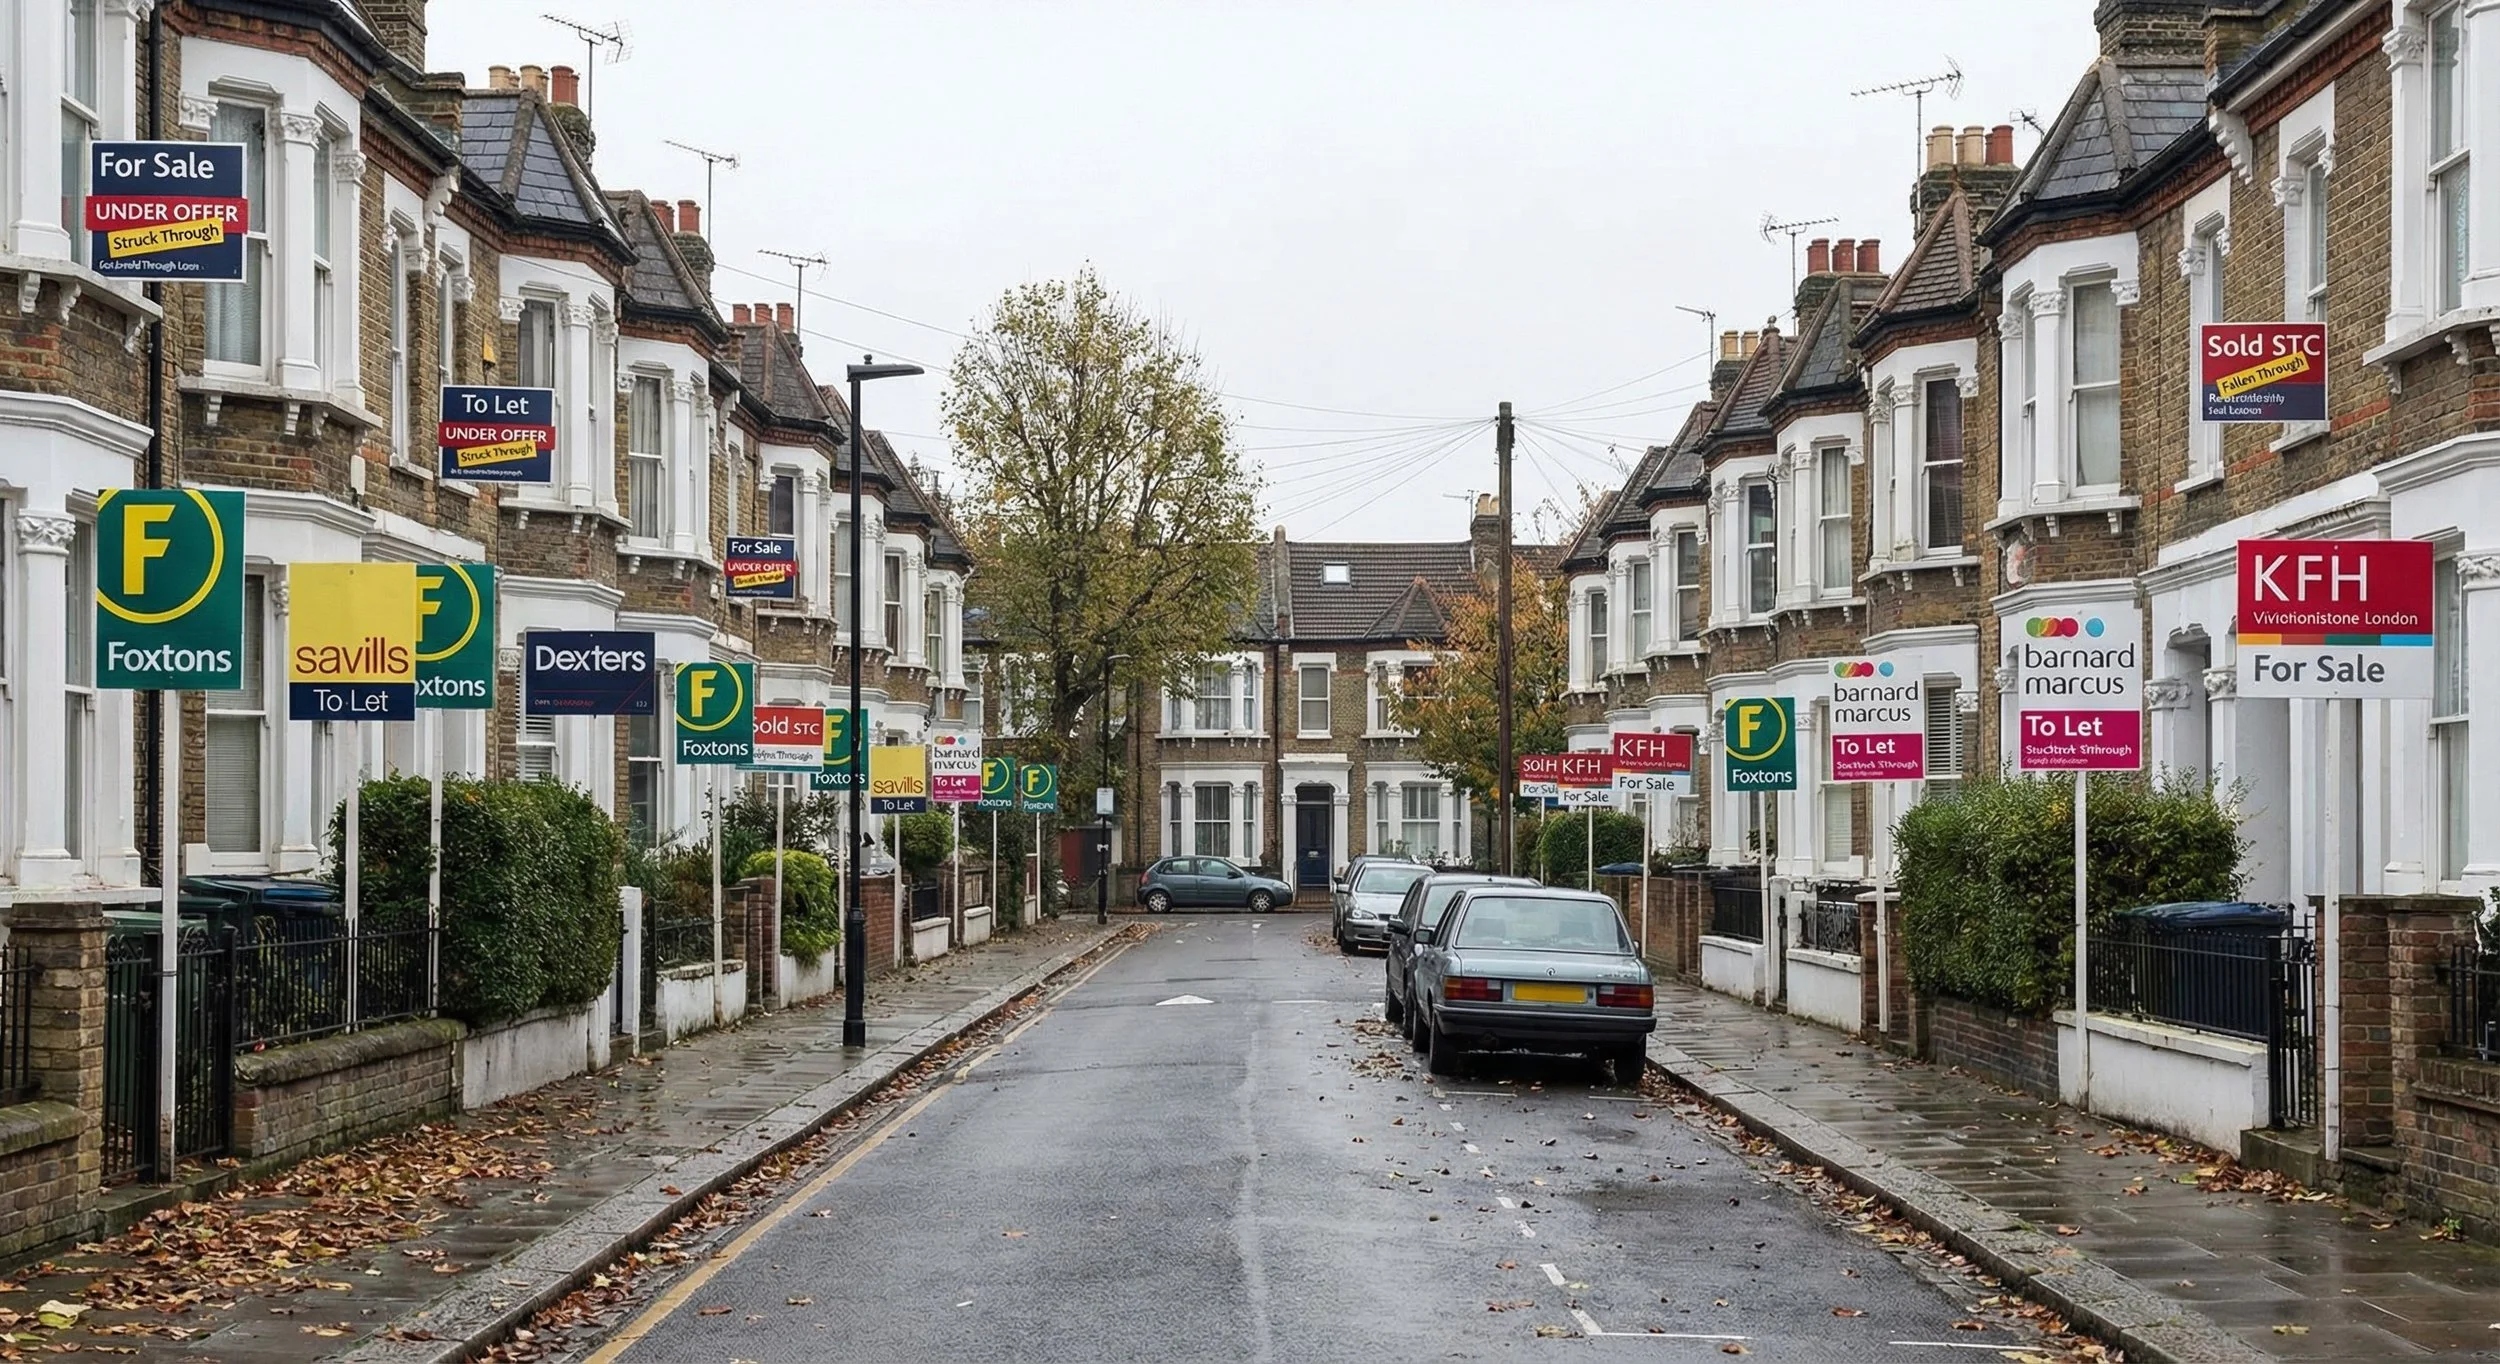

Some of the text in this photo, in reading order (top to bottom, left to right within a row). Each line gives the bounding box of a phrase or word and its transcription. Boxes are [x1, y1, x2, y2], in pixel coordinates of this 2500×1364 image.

[100, 151, 215, 179] For Sale
[95, 203, 239, 222] UNDER OFFER
[113, 223, 219, 250] Struck Through
[2208, 333, 2321, 357] Sold STC
[2221, 356, 2304, 393] Fallen Through
[461, 394, 529, 415] To Let
[445, 427, 547, 443] UNDER OFFER
[123, 504, 176, 595] F
[731, 541, 782, 554] For Sale
[2254, 555, 2368, 602] KFH
[2365, 611, 2418, 625] London
[108, 641, 232, 673] Foxtons
[295, 637, 409, 674] savills
[535, 645, 646, 672] Dexters
[2025, 642, 2134, 668] barnard
[2254, 654, 2385, 683] For Sale
[691, 670, 718, 718] F
[1834, 681, 1919, 702] barnard
[2025, 676, 2124, 694] marcus
[313, 689, 388, 712] To Let
[1835, 707, 1911, 723] marcus
[2026, 715, 2103, 736] To Let
[793, 722, 820, 735] STC
[1739, 705, 1764, 749] F
[683, 740, 749, 756] Foxtons
[1619, 738, 1665, 758] KFH
[1836, 738, 1896, 755] To Let
[983, 762, 998, 787] F
[1562, 758, 1600, 774] KFH
[1732, 768, 1793, 784] Foxtons
[873, 776, 924, 795] savills
[935, 777, 948, 787] To
[1027, 770, 1040, 792] F
[1619, 776, 1643, 789] For
[1646, 777, 1675, 791] Sale
[881, 799, 915, 811] To Let
[1563, 790, 1609, 803] For Sale
